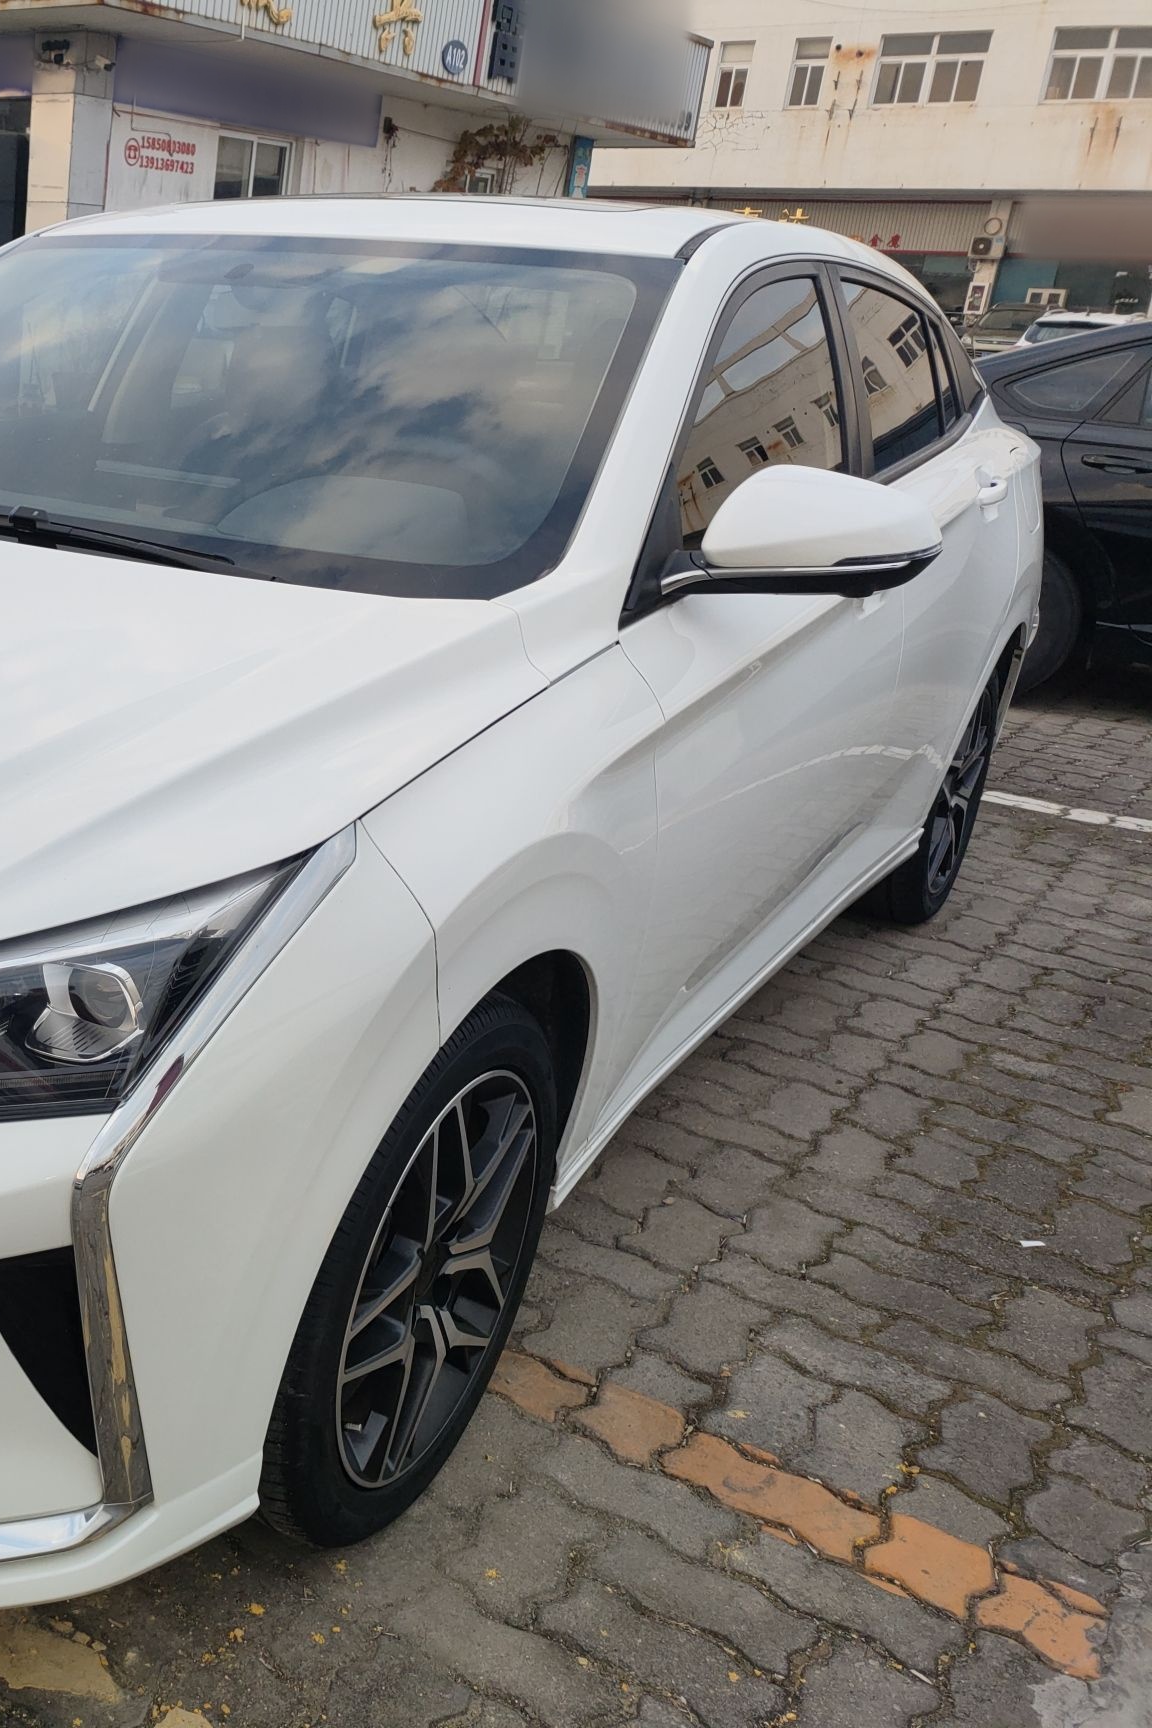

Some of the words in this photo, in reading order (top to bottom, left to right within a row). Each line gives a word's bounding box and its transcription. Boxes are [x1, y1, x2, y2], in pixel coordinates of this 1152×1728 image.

[445, 45, 466, 69] A102
[140, 136, 196, 157] 15850803080
[139, 155, 194, 175] 13913697423
